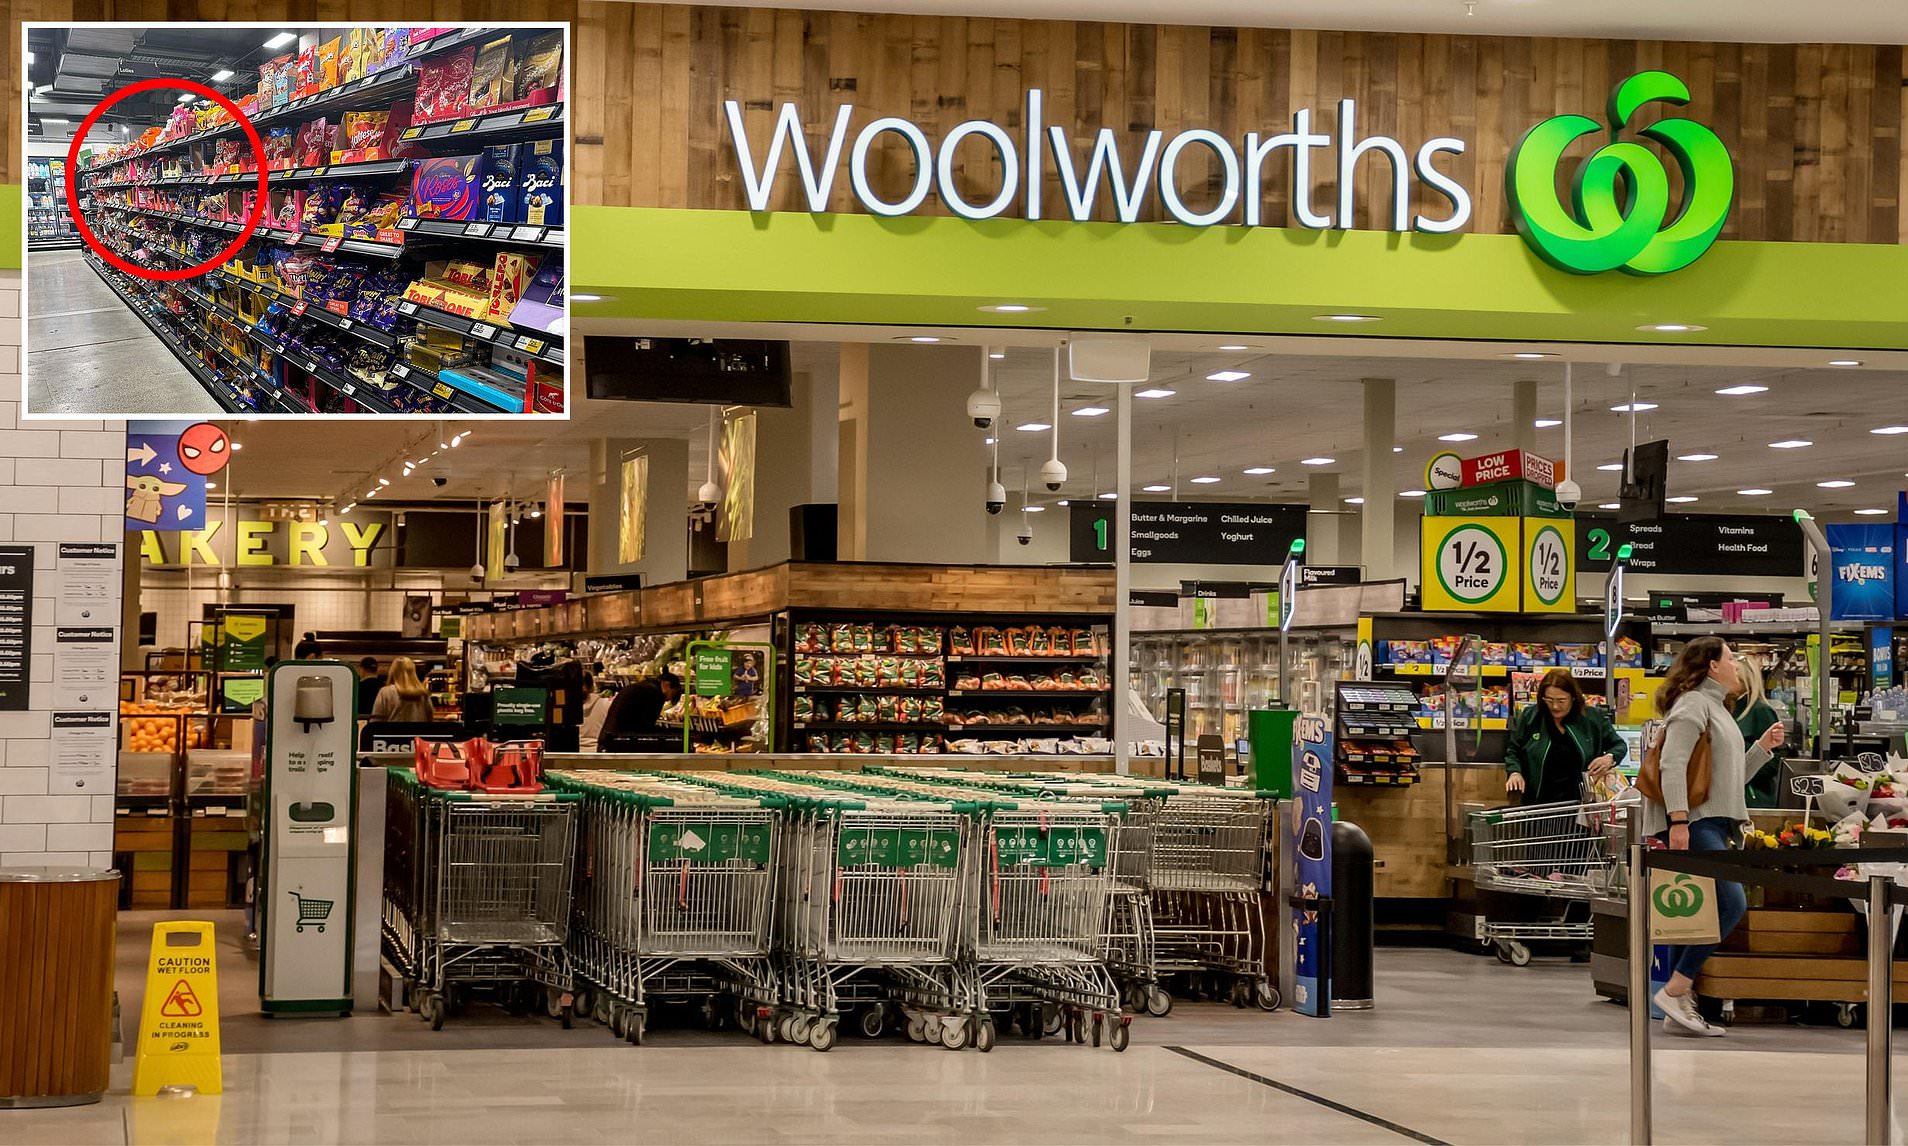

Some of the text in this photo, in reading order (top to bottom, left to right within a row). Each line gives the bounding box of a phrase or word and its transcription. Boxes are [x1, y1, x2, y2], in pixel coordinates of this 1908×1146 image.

[724, 88, 1472, 233] Woolworths
[482, 174, 512, 192] Baci
[522, 173, 555, 192] Baci
[1477, 455, 1505, 470] LOW
[1526, 456, 1552, 476] PRICES
[1434, 467, 1460, 482] Special
[1475, 465, 1510, 482] PRICE
[1526, 468, 1552, 485] DROPPED
[1131, 514, 1208, 524] Butter & Margarine
[1221, 515, 1273, 524] Chilled Juice
[1093, 518, 1107, 550] 1
[1131, 530, 1179, 540] Smallgoods
[1629, 524, 1662, 534] Spreads
[1718, 526, 1754, 535] Vitamins
[1220, 532, 1254, 542] Yoghurt
[1587, 528, 1610, 560] 2
[1630, 541, 1654, 550] Bread
[1718, 543, 1768, 552] Health Food
[1131, 548, 1152, 558] Eggs
[1452, 541, 1490, 574] 1/2
[1539, 543, 1559, 576] 1/2
[1629, 558, 1656, 568] Wraps
[1455, 576, 1488, 588] Price
[1539, 577, 1558, 590] Price
[1794, 778, 1823, 795] $25
[158, 958, 210, 967] CAUTION
[157, 966, 210, 974] WET FLOOR
